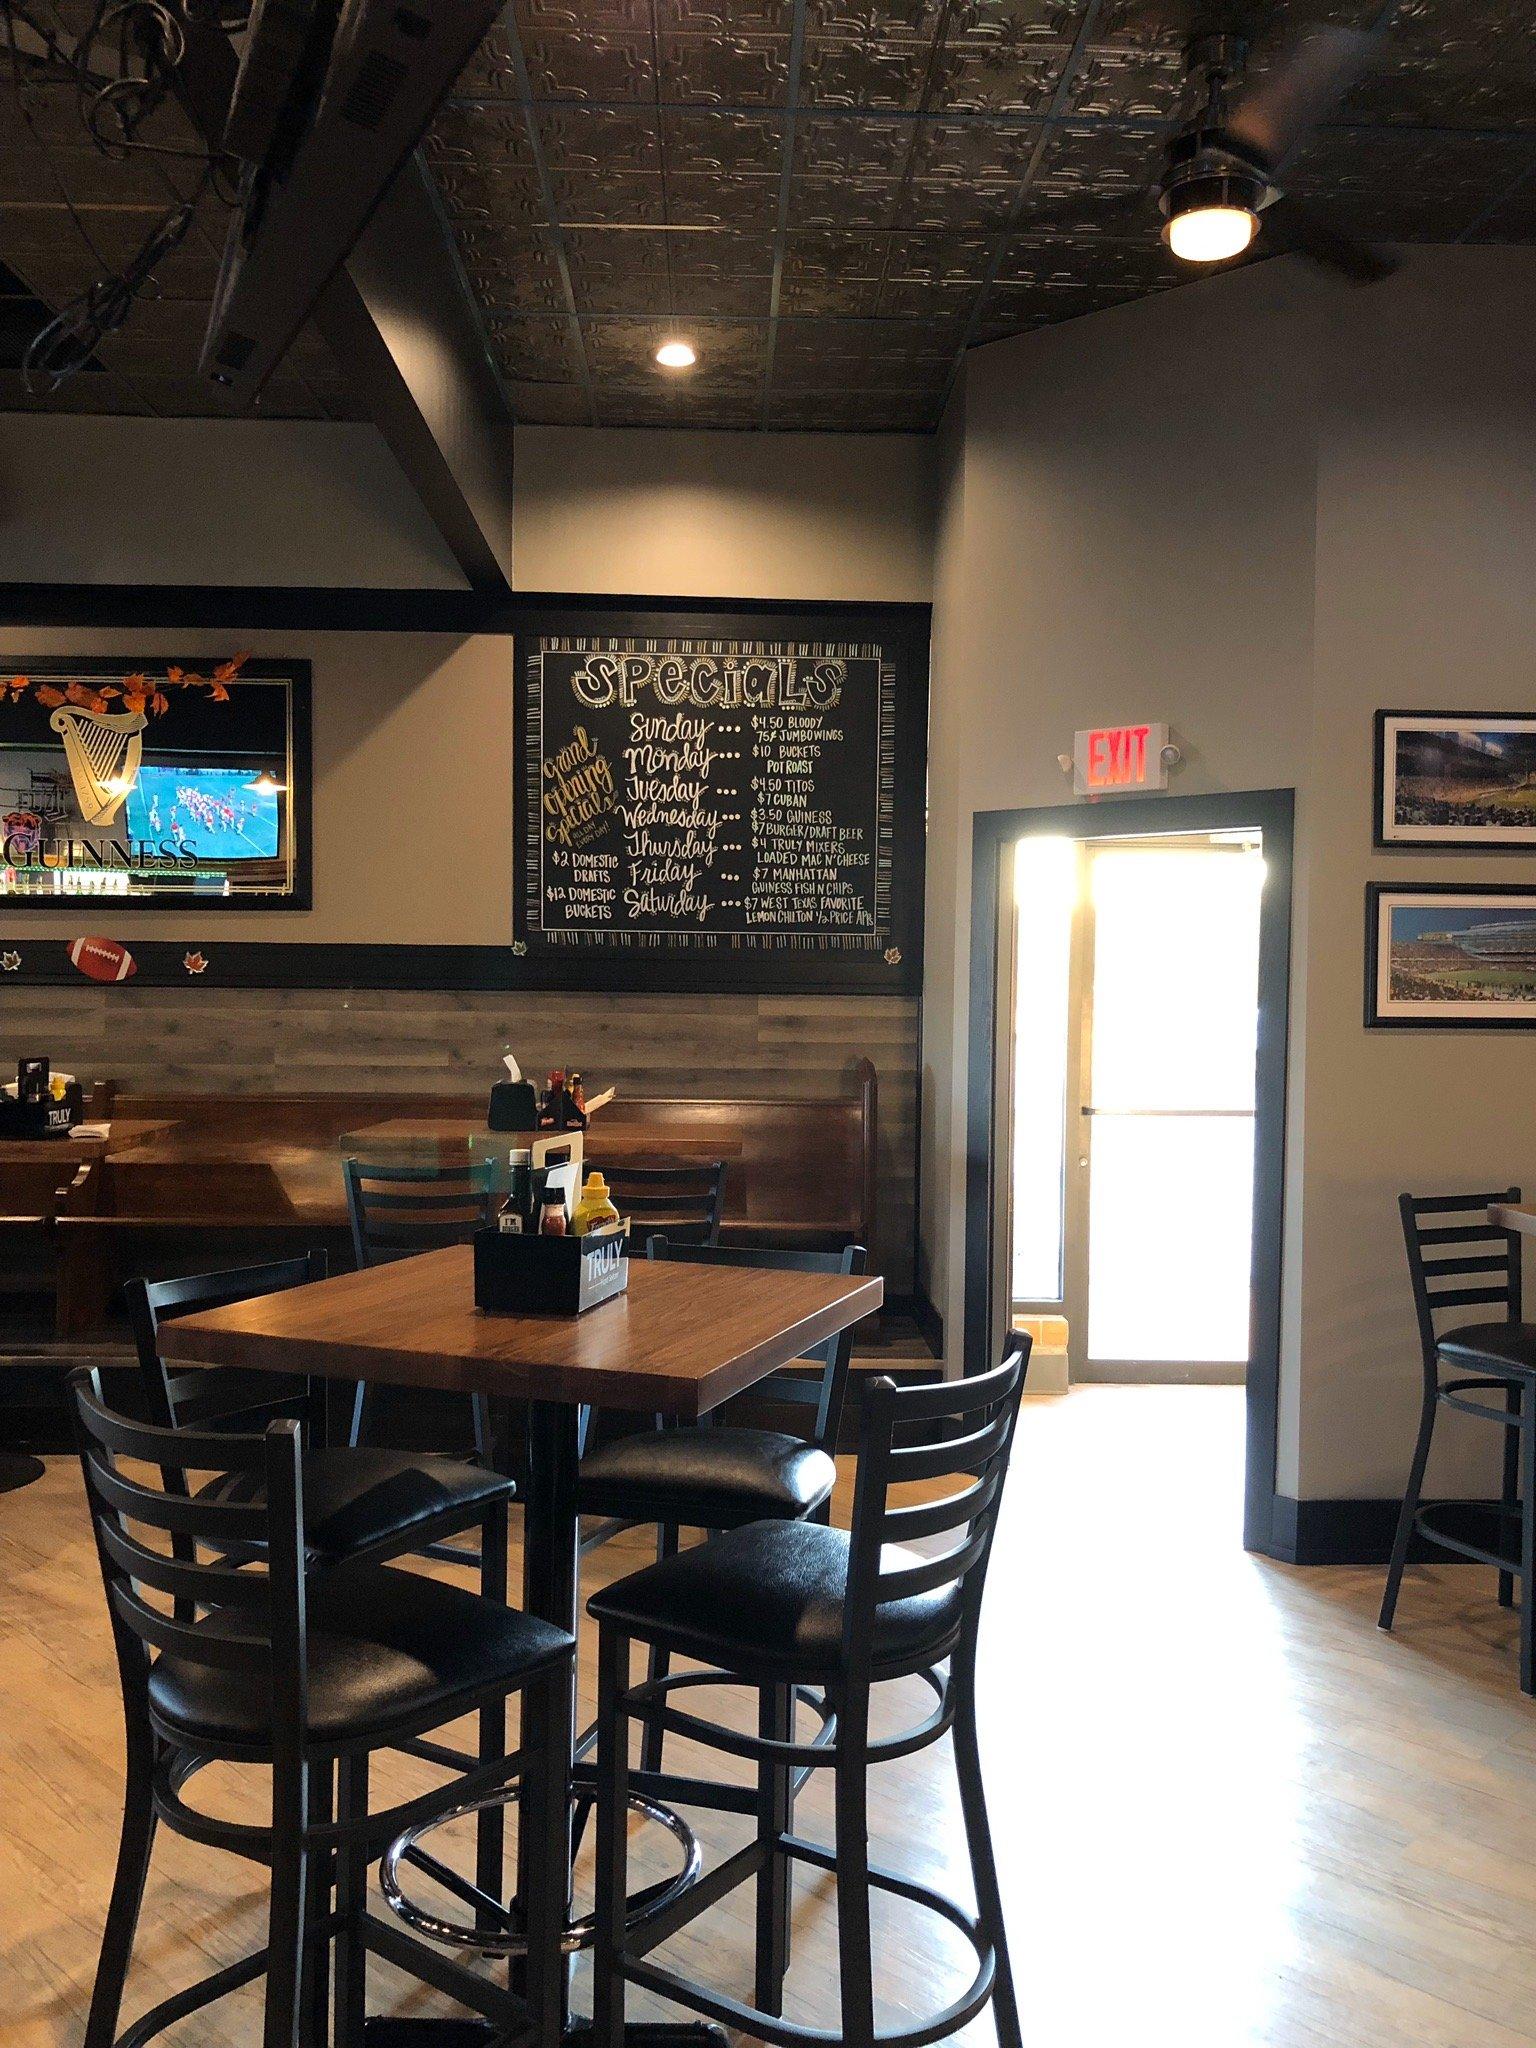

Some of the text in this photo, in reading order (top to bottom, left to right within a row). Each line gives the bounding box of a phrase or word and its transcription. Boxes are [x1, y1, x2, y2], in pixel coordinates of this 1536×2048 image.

[630, 712, 715, 750] Sunday
[751, 714, 823, 730] $4.50 BLOODY
[752, 744, 821, 759] $10 BUCKETS
[1088, 726, 1150, 786] EXIT
[624, 743, 718, 779] Monday
[767, 760, 813, 774] POT ROAST
[625, 775, 709, 810] Tuesday
[785, 779, 815, 793] TITOS
[757, 791, 807, 807] $7 CUBAN
[614, 803, 723, 839] Wednesday
[750, 807, 832, 824] $3.50 GUINESS
[751, 820, 765, 835] $7
[839, 828, 863, 840] BEER
[3, 833, 199, 869] GUINNESS
[623, 830, 718, 866] Thursday
[752, 836, 845, 854] $4 TRULY MIXERS
[552, 850, 619, 868] $2 DOMESTIC
[757, 851, 798, 864] LOADED
[801, 853, 822, 867] MAC
[574, 869, 611, 883] DRAFTS
[628, 858, 702, 891] Friday
[753, 866, 837, 881] $7 MANHATTAN
[546, 885, 616, 903] $12 DOMESTIC
[751, 882, 853, 895] GUINESS FISH N CHIPS
[565, 904, 612, 920] BUCKETS
[624, 888, 715, 922] Saturday
[744, 896, 864, 910] $7 WEST TEXAS FAVORITE
[746, 911, 776, 924] LEMON
[830, 910, 854, 924] PRICE
[49, 1108, 72, 1126] TRULY
[587, 1238, 623, 1281] TRULY
